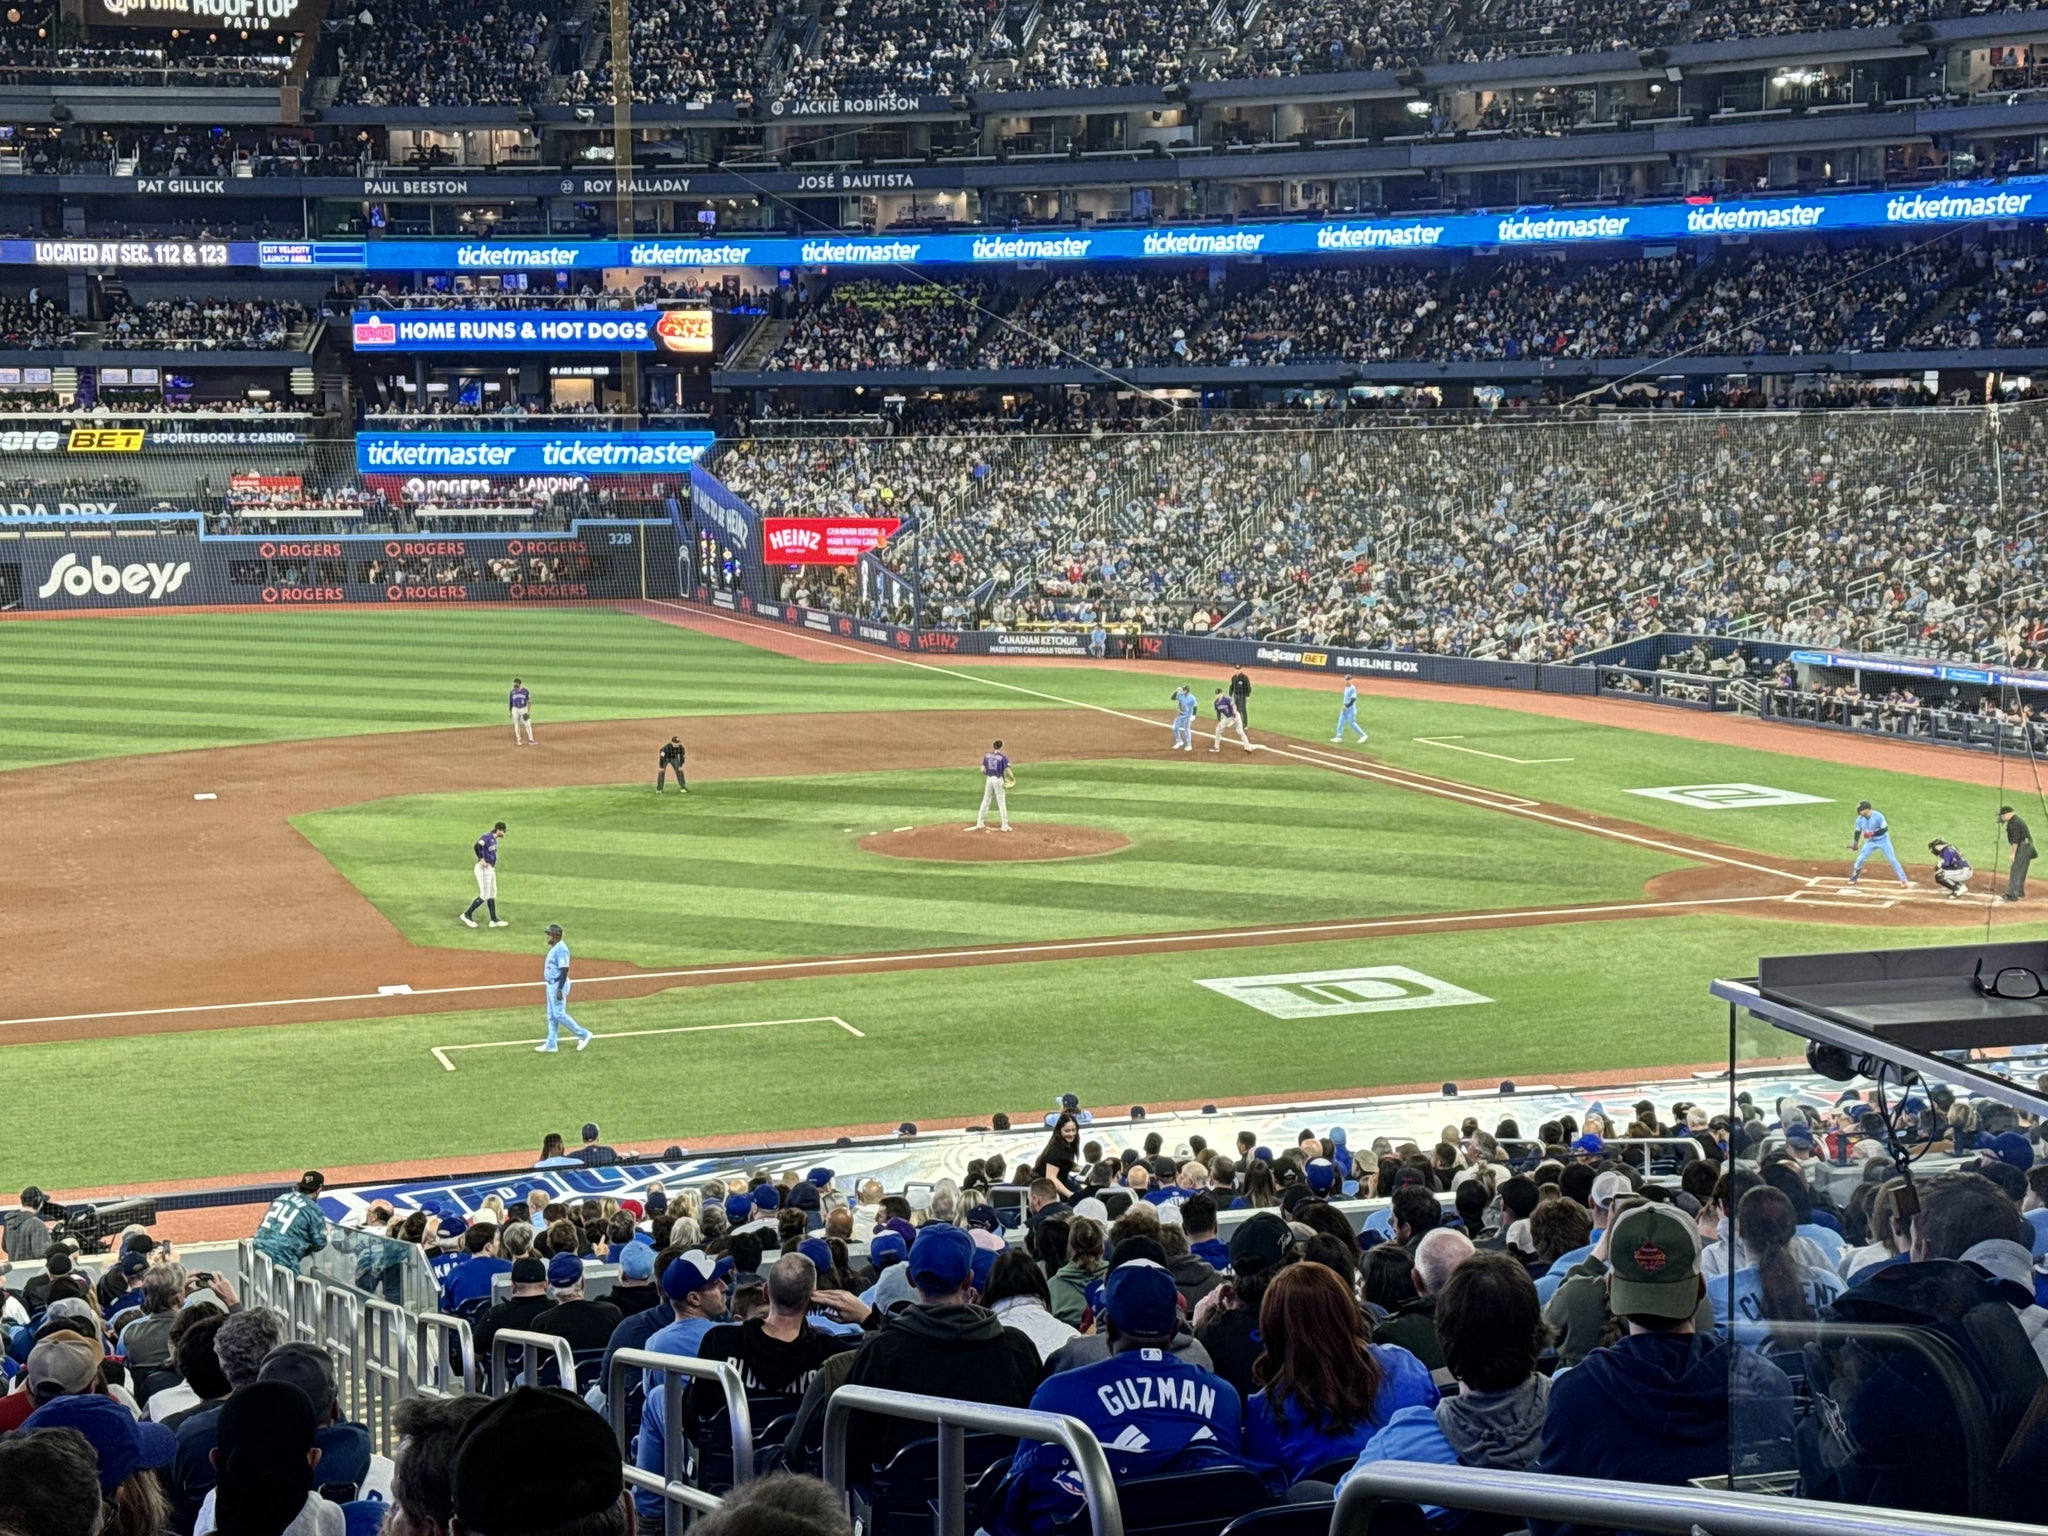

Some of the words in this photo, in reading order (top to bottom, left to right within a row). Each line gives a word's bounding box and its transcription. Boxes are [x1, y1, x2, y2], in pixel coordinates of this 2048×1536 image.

[193, 0, 298, 18] ROOFTOP
[223, 16, 270, 30] PATIO
[792, 101, 840, 115] JACKIE
[844, 98, 919, 112] ROBINSON
[138, 180, 164, 193] PAT
[169, 180, 225, 194] GILLICK
[364, 181, 399, 194] PAUL
[403, 181, 468, 194] BEESTON
[584, 180, 612, 193] ROY
[617, 179, 690, 192] HALLADAY
[798, 172, 834, 190] JOSÉ
[843, 173, 915, 188] BAUTISTA
[1886, 190, 2032, 222] ticketmaster
[1687, 203, 1825, 232] ticketmaster
[1317, 223, 1444, 249] ticketmaster
[1499, 213, 1630, 242] ticketmaster
[801, 238, 921, 263] ticketmaster
[972, 236, 1092, 259] ticketmaster
[1143, 230, 1264, 255] ticketmaster
[35, 243, 98, 263] LOCATED
[101, 244, 118, 263] AT
[121, 244, 153, 263] SEC.
[155, 244, 179, 263] 112
[182, 244, 196, 263] &
[199, 244, 227, 263] 123
[457, 245, 579, 266] ticketmaster
[630, 243, 752, 266] ticketmaster
[401, 322, 456, 339] HOME
[460, 322, 516, 339] RUNS
[520, 322, 537, 339] &
[541, 322, 588, 339] HOT
[591, 322, 647, 339] DOGS
[72, 432, 141, 448] BET
[152, 432, 235, 444] SPORTSBOOK
[238, 432, 247, 443] &
[250, 432, 296, 443] CASINO
[367, 441, 516, 466] ticketmaster
[542, 440, 706, 466] ticketmaster
[426, 479, 490, 494] ROGERS
[527, 541, 586, 553] ROGERS
[608, 533, 632, 545] 328
[769, 528, 822, 551] HEINZ
[280, 543, 341, 557] ROGERS
[405, 542, 465, 555] ROGERS
[39, 553, 191, 599] Sobeys
[281, 588, 343, 600] ROGERS
[405, 586, 466, 598] ROGERS
[528, 584, 587, 596] ROGERS
[917, 634, 960, 648] HEINZ
[998, 635, 1039, 645] CANADIAN
[1040, 635, 1079, 646] KETCHUP.
[990, 645, 1006, 653] MADE
[1023, 646, 1053, 654] CANADIAN
[1257, 648, 1301, 662] theScore
[1304, 654, 1326, 663] BET
[1337, 656, 1392, 671] BASELINE
[1394, 661, 1419, 673] BOX
[261, 1201, 300, 1234] 24
[1097, 1376, 1217, 1420] GUZMAN
